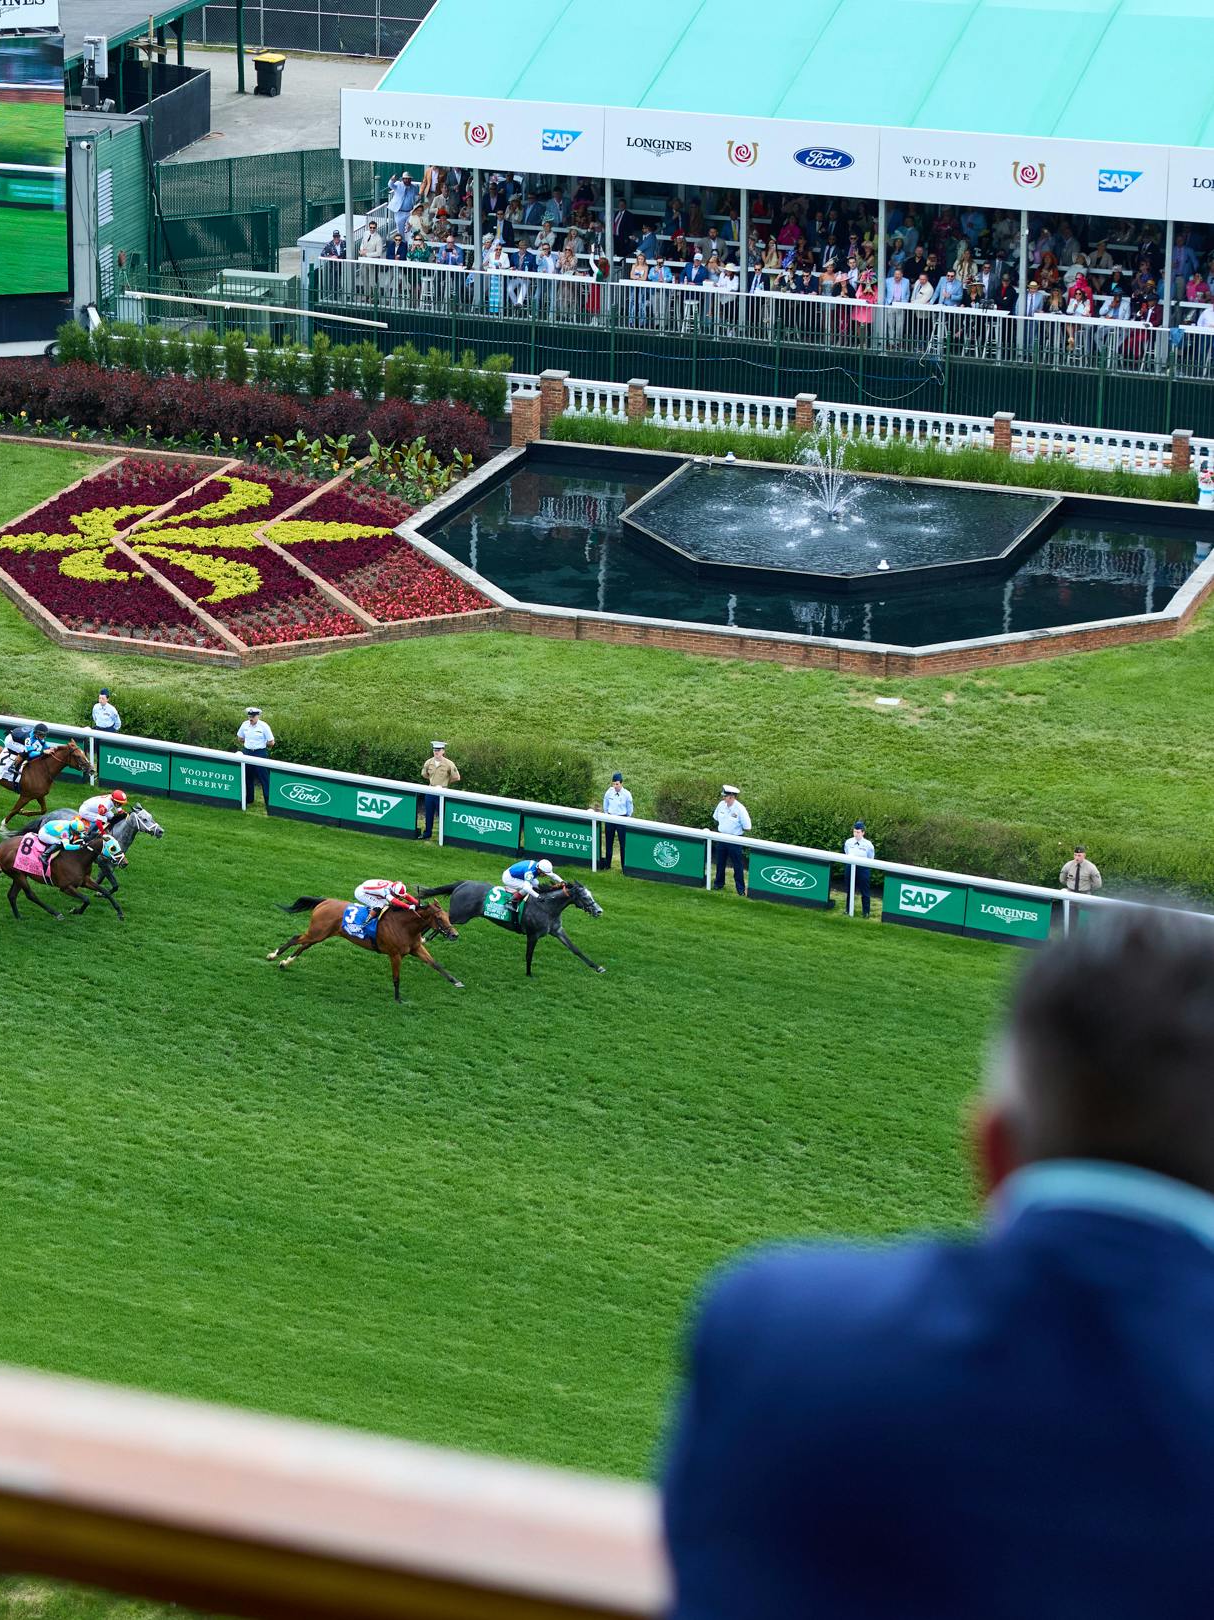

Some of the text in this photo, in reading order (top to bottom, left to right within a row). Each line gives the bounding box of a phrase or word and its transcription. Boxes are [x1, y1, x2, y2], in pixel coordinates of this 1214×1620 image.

[363, 116, 432, 130] WOODFORD
[371, 129, 426, 141] RESERVE
[542, 132, 574, 148] SAP
[626, 137, 692, 152] LONGINES
[805, 149, 843, 168] Ford
[902, 155, 977, 169] WOODFORD
[909, 168, 971, 181] RESERVE
[1099, 172, 1133, 189] SAP
[1193, 177, 1214, 189] LO
[106, 755, 163, 772] LONGINES
[179, 766, 235, 782] WOODFORD
[185, 777, 231, 791] RESERVE
[289, 784, 322, 804] Ford
[358, 796, 391, 815] SAP
[452, 813, 513, 832] LONGINES
[534, 826, 593, 842] WOODFORD
[20, 837, 35, 856] 8
[540, 837, 589, 851] RESERVE
[770, 868, 807, 887] Ford
[489, 886, 506, 902] 5
[901, 889, 938, 909] SAP
[345, 905, 359, 924] 3
[981, 903, 1038, 922] LONGINES
